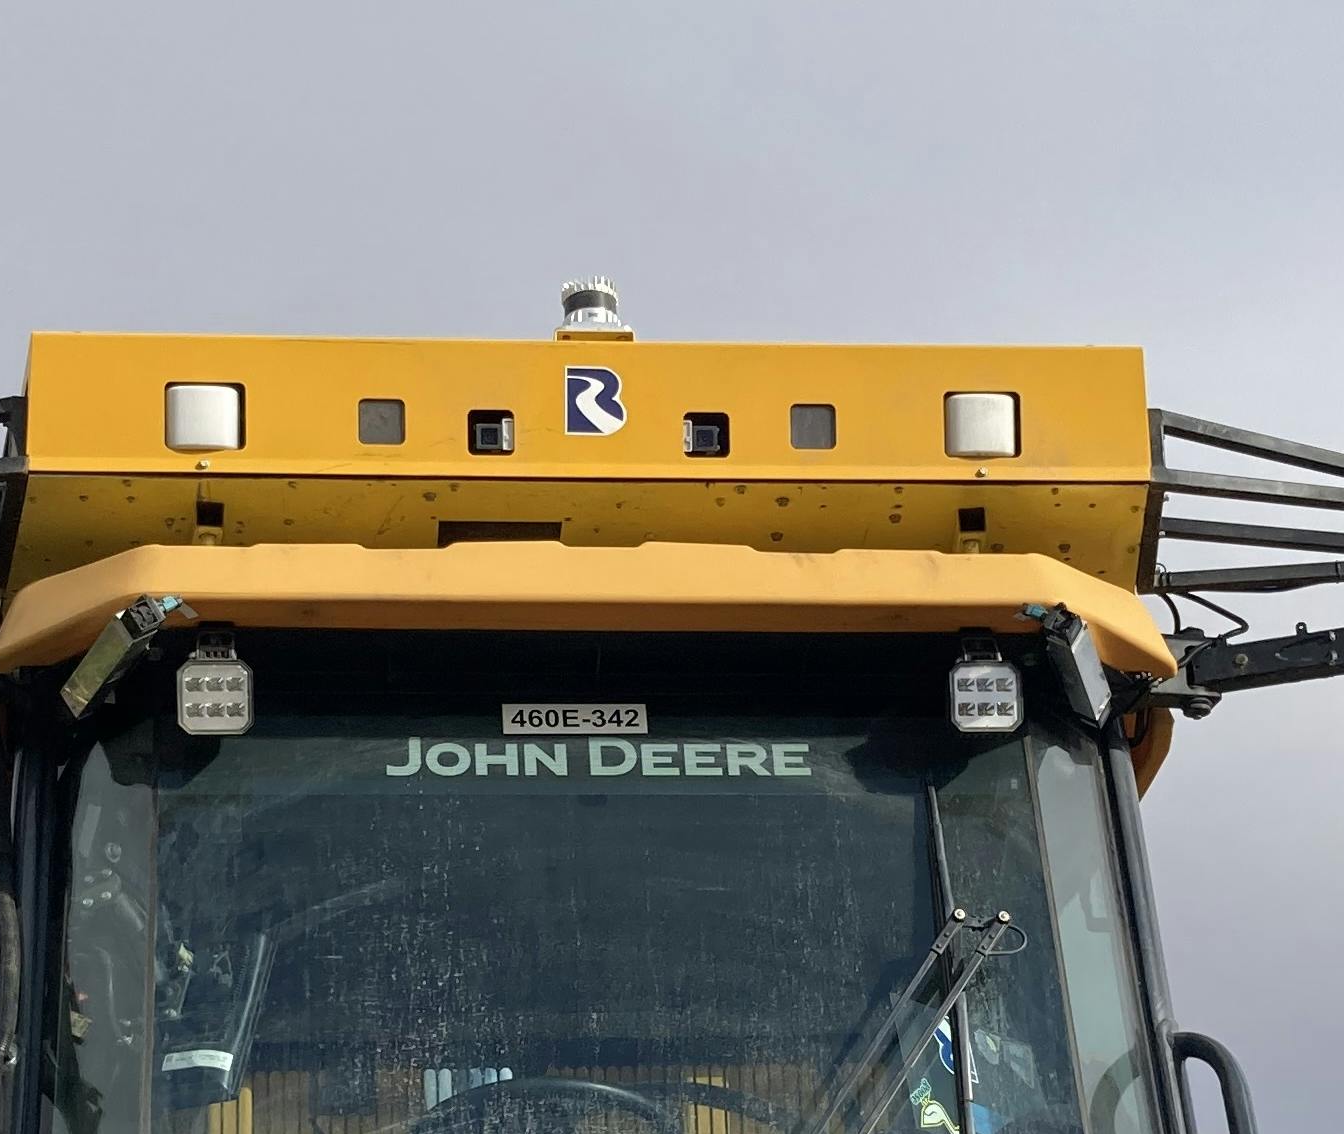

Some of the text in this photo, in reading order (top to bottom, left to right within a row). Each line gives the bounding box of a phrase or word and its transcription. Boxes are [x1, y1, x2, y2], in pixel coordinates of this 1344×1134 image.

[510, 708, 640, 728] 460E-342
[386, 737, 812, 776] JOHN DEERE
